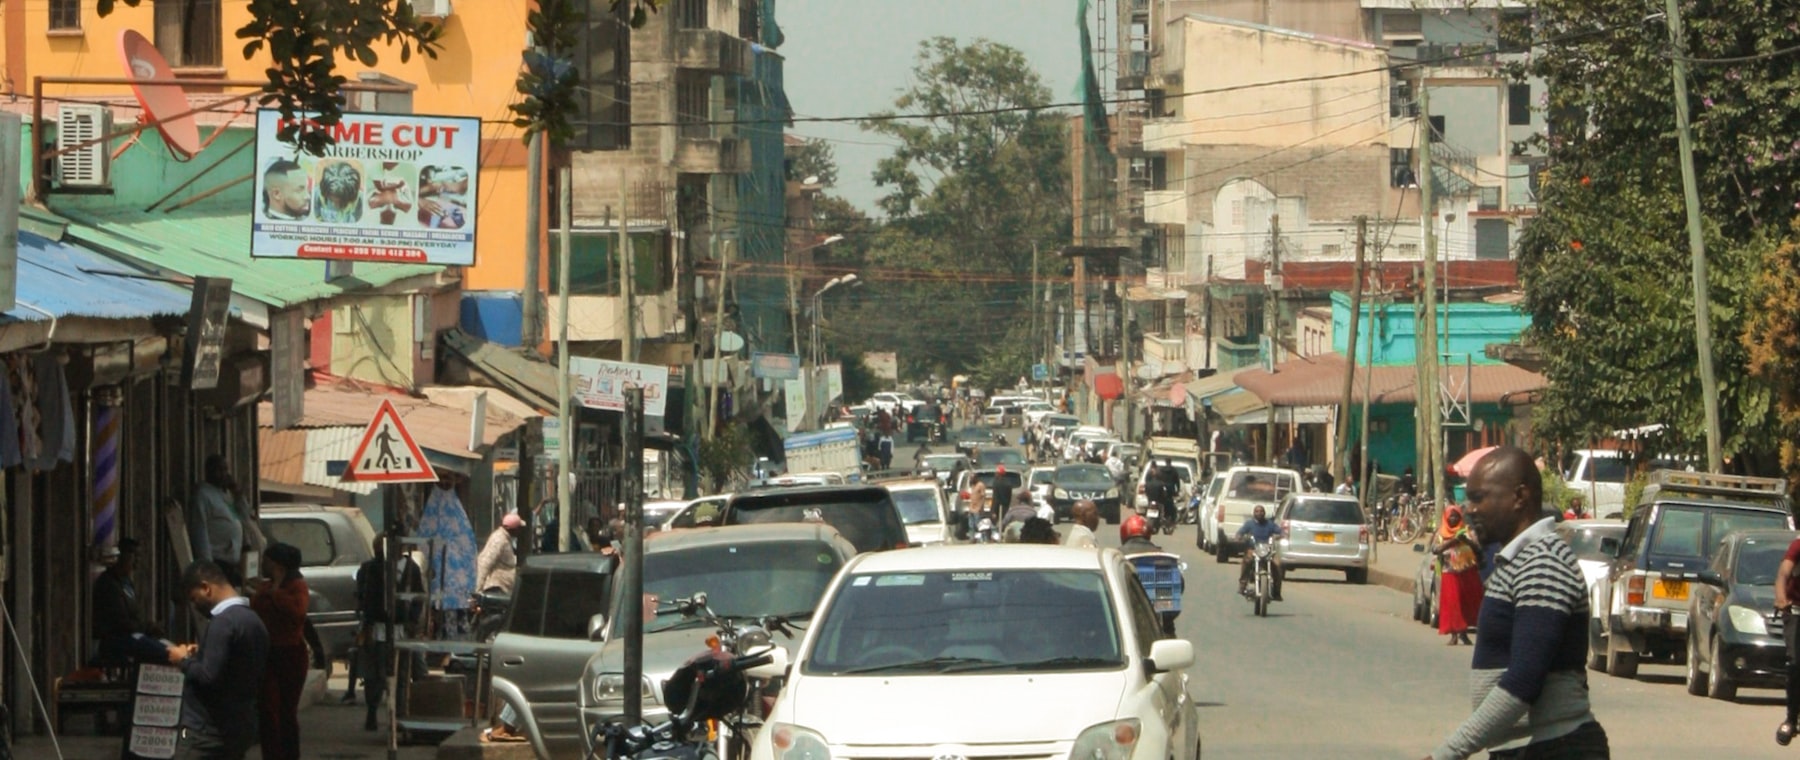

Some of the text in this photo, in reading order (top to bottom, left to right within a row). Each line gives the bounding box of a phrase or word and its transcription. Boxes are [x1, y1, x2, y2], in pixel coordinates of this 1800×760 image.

[391, 124, 460, 150] CUT
[318, 145, 423, 162] ARBERSHOP
[304, 245, 332, 253] Contact
[310, 235, 337, 243] HOURS
[414, 241, 457, 249] EVERYDAY
